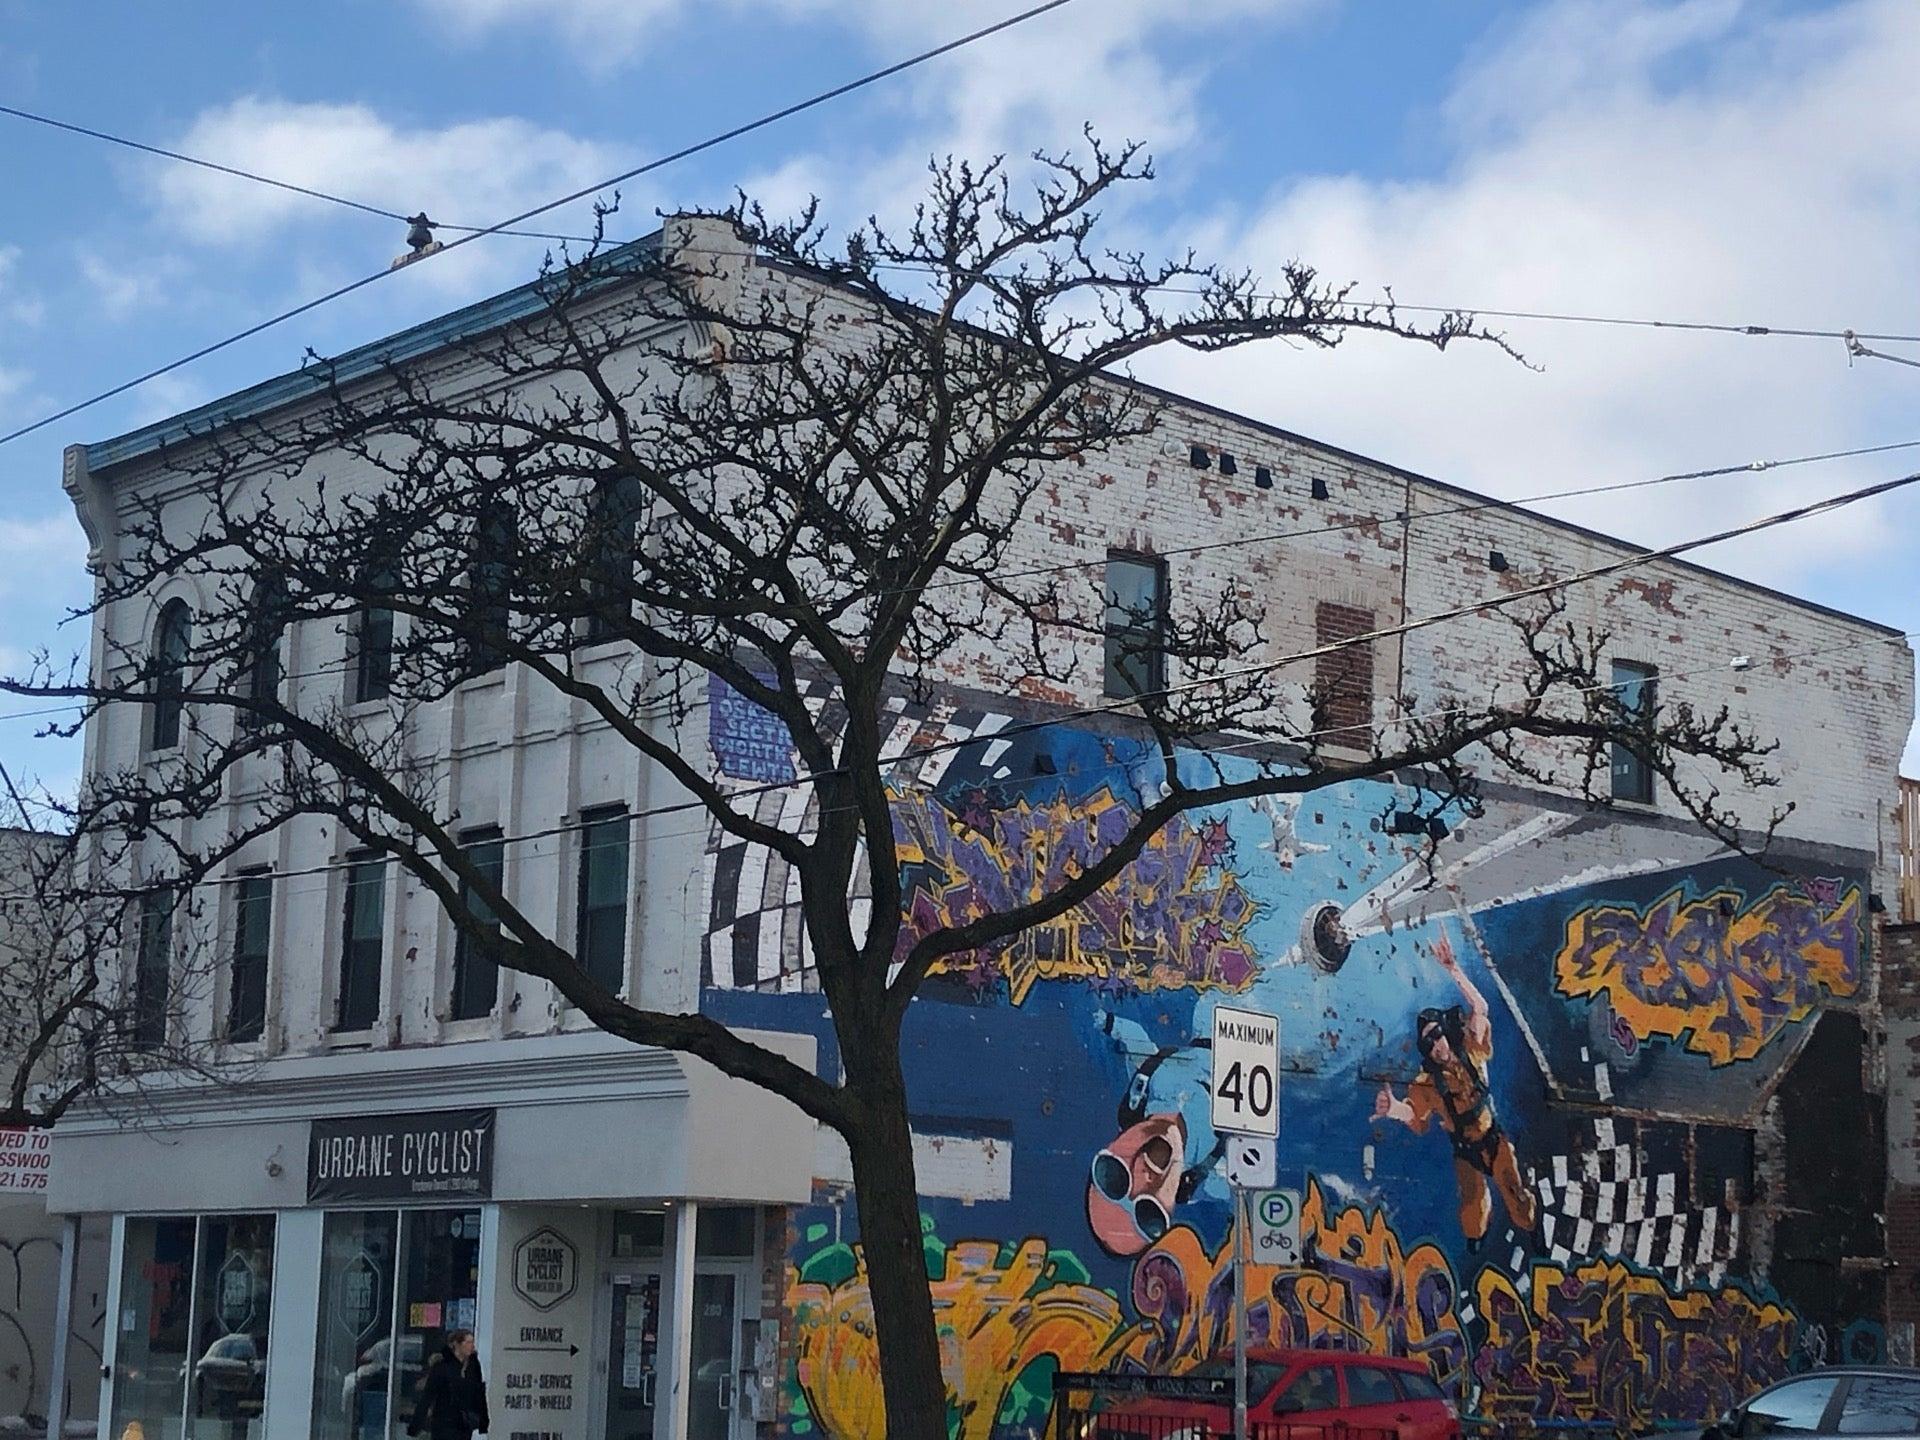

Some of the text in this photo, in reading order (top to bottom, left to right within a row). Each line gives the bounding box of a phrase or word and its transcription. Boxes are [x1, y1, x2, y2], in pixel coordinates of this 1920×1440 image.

[1218, 1020, 1274, 1047] MAXIMUM
[1217, 1061, 1273, 1117] 40
[31, 1134, 50, 1150] TO
[318, 1129, 485, 1179] URBANE CYCLIST
[1269, 1201, 1284, 1220] P
[527, 1247, 564, 1263] URBANE
[526, 1263, 563, 1280] CYCLIST
[520, 1326, 563, 1343] ENTRANCE
[506, 1373, 573, 1390] SALES SERVICE
[504, 1394, 573, 1411] PARTS WHEELS
